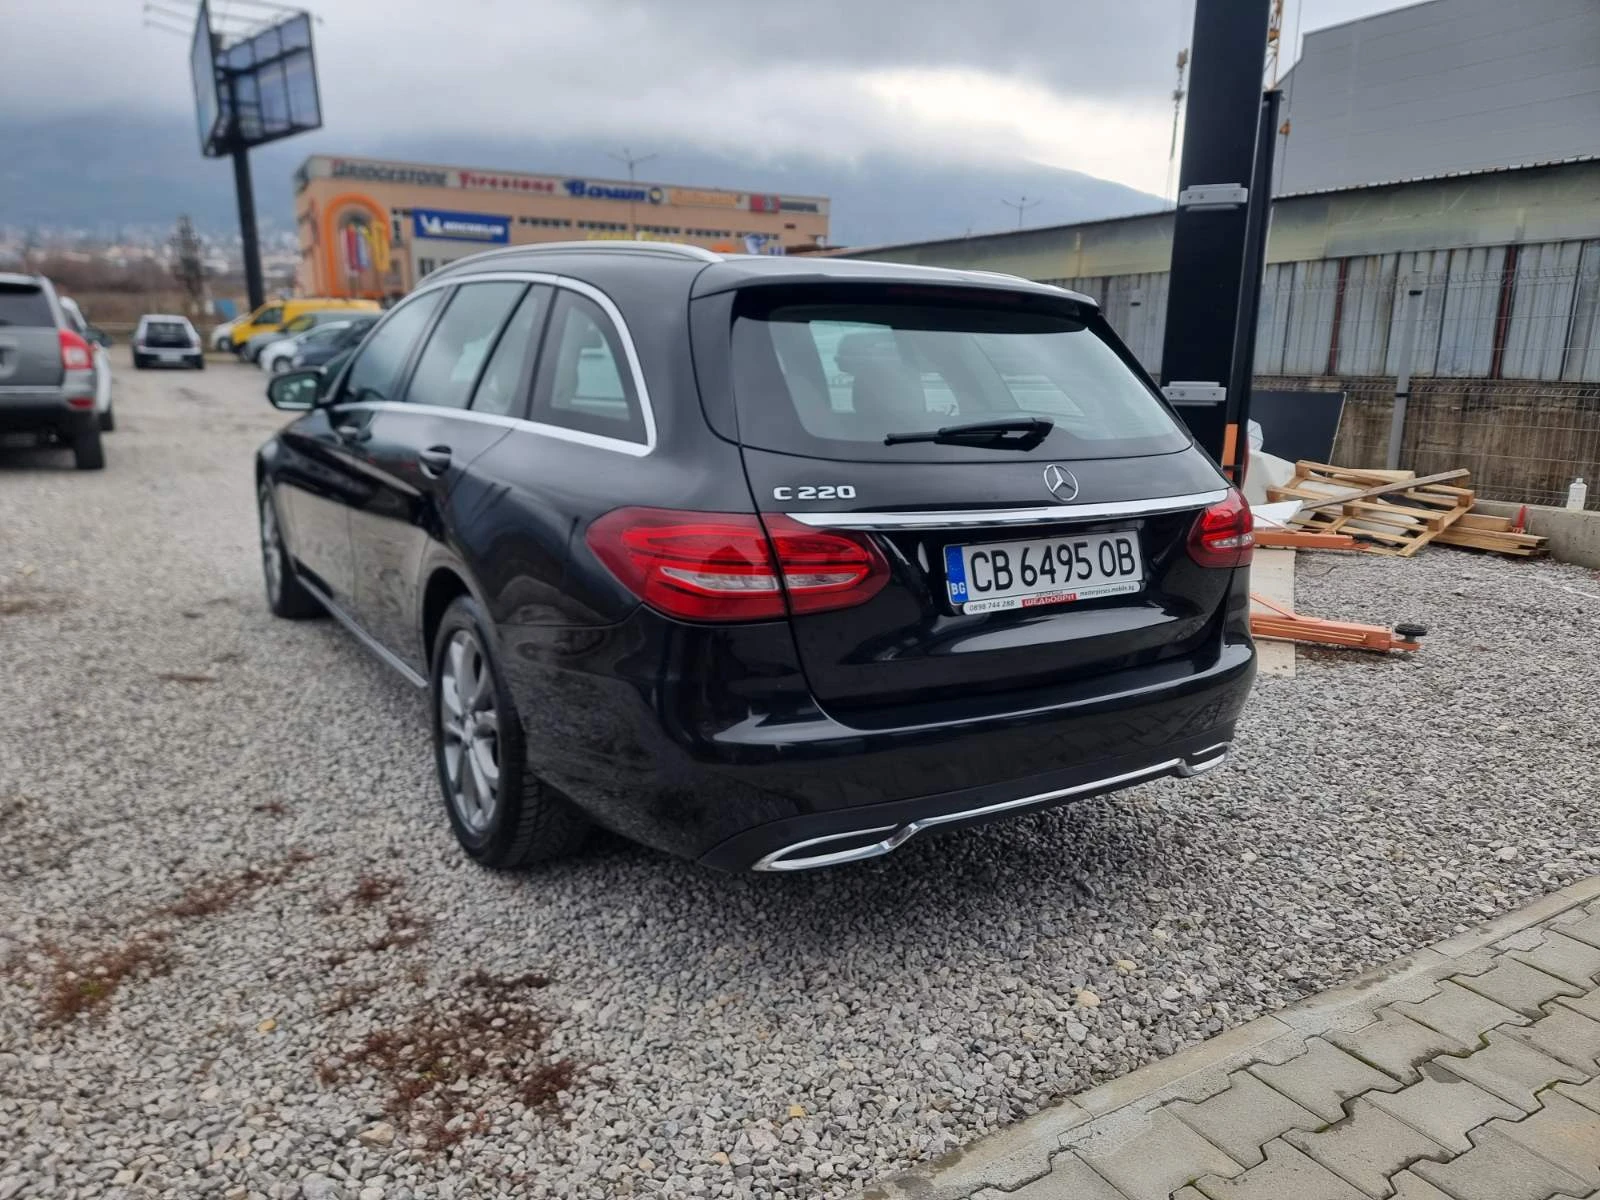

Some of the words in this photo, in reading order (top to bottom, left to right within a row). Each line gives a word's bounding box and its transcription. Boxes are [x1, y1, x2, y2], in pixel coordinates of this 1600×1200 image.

[458, 171, 556, 193] Firestone
[773, 486, 793, 500] C
[797, 485, 857, 500] 220
[970, 549, 1013, 592] CB
[1020, 541, 1093, 587] 6495
[950, 582, 966, 596] BG
[988, 601, 1000, 610] 744
